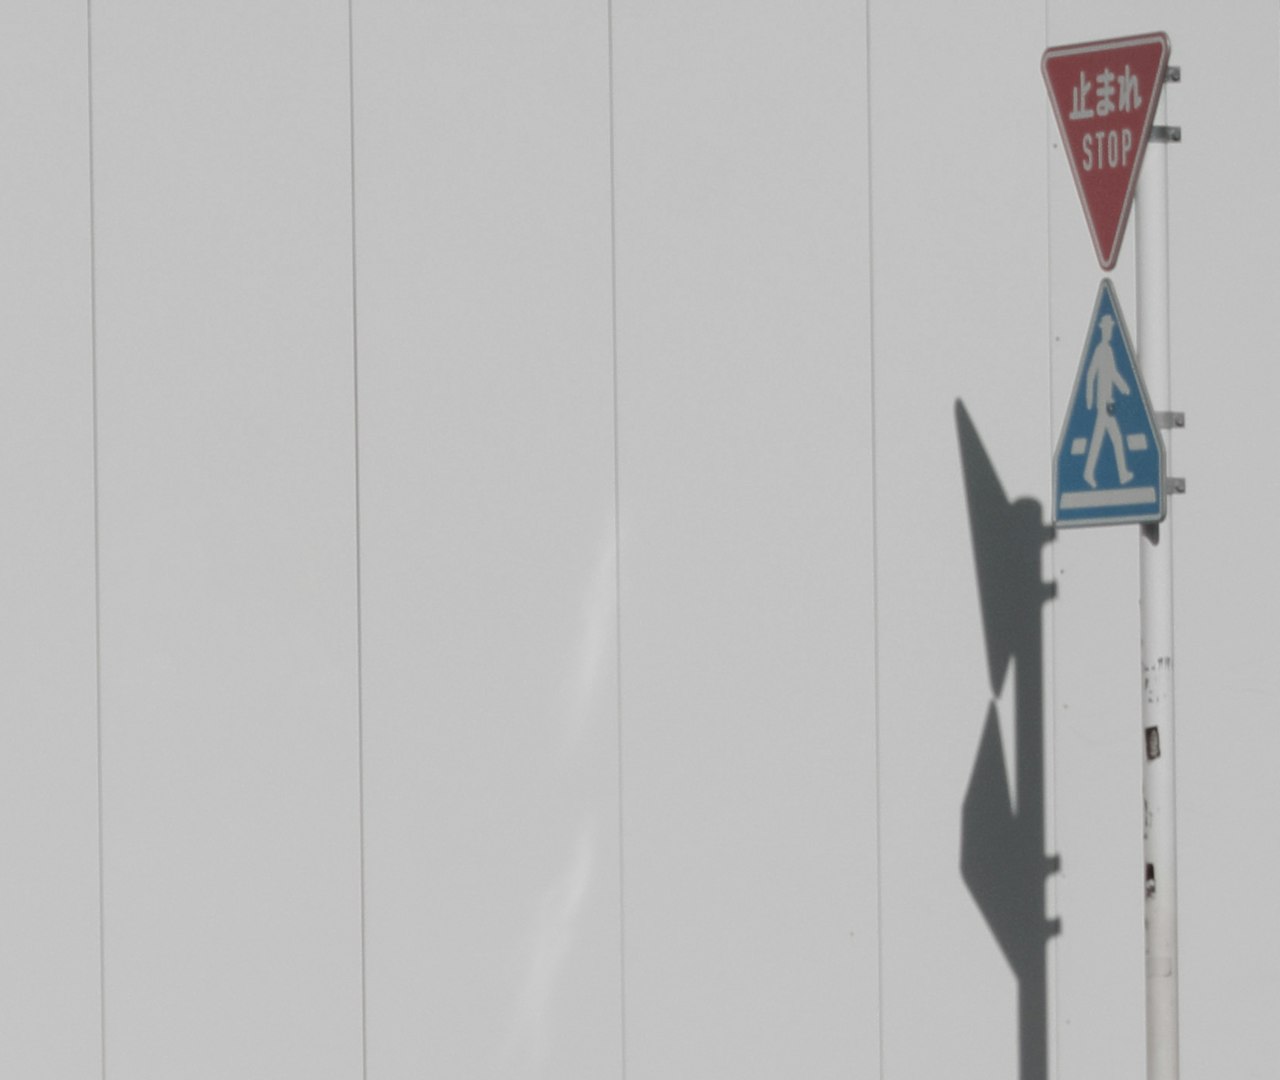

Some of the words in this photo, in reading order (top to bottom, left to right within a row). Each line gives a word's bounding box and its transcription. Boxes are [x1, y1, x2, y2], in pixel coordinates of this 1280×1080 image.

[1069, 64, 1142, 120] 止まれ
[1082, 128, 1132, 171] STOP
